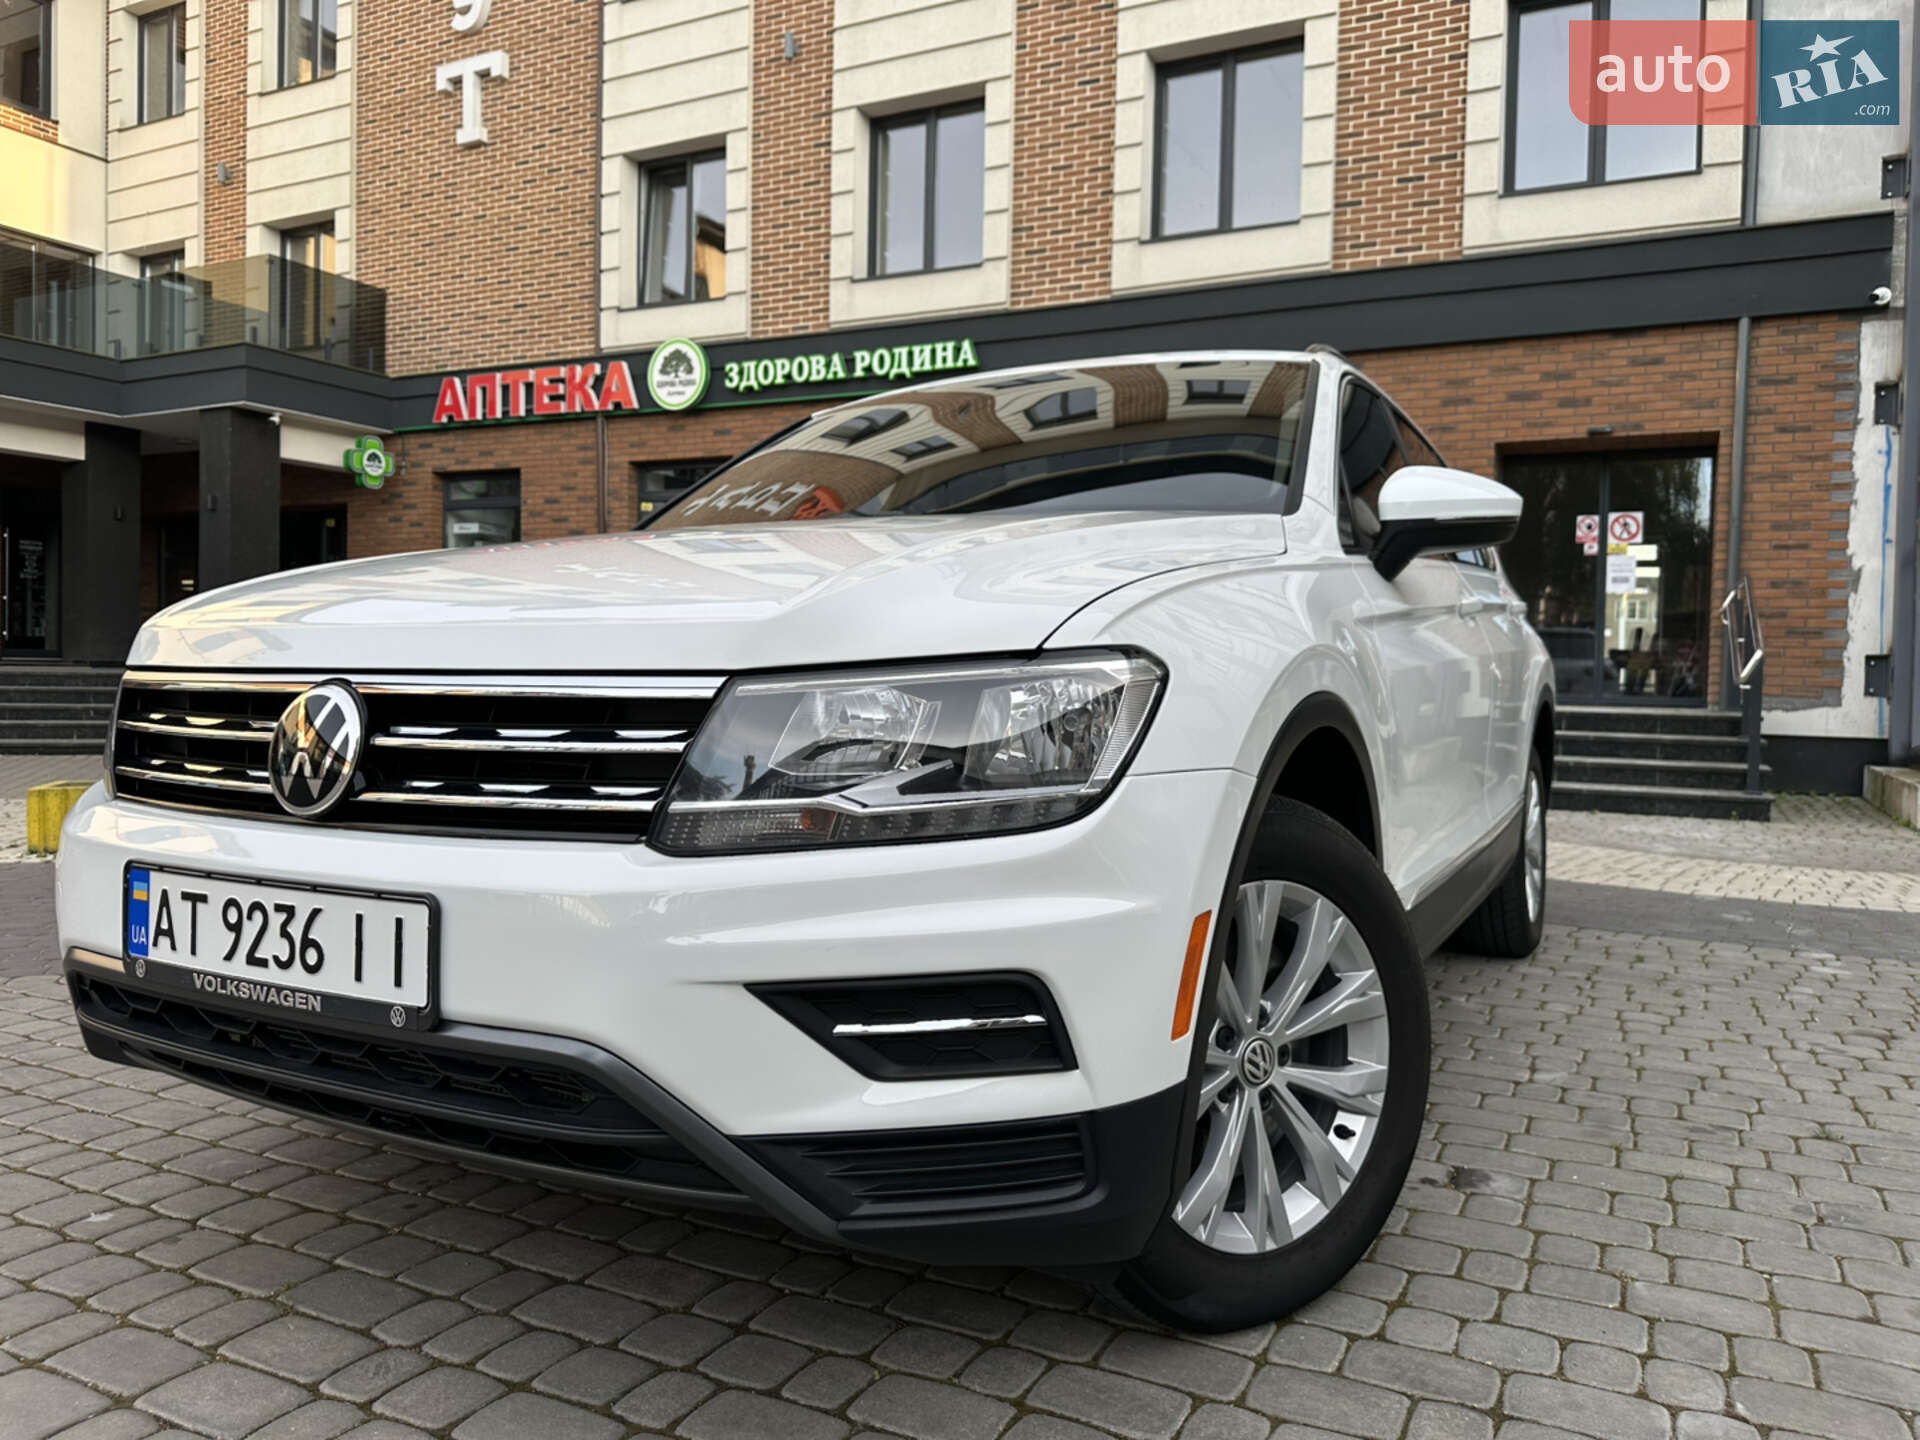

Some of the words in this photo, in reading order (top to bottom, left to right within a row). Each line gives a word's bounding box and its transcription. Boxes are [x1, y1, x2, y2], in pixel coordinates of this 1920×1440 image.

[433, 360, 640, 424] АПТЕКА
[724, 354, 846, 393] ЗДОРОВА
[853, 338, 978, 378] РОДИНА
[131, 925, 148, 945] UA
[152, 888, 208, 956] AT
[221, 897, 325, 975] 9236
[192, 972, 322, 1013] VOLKSWAGEN
